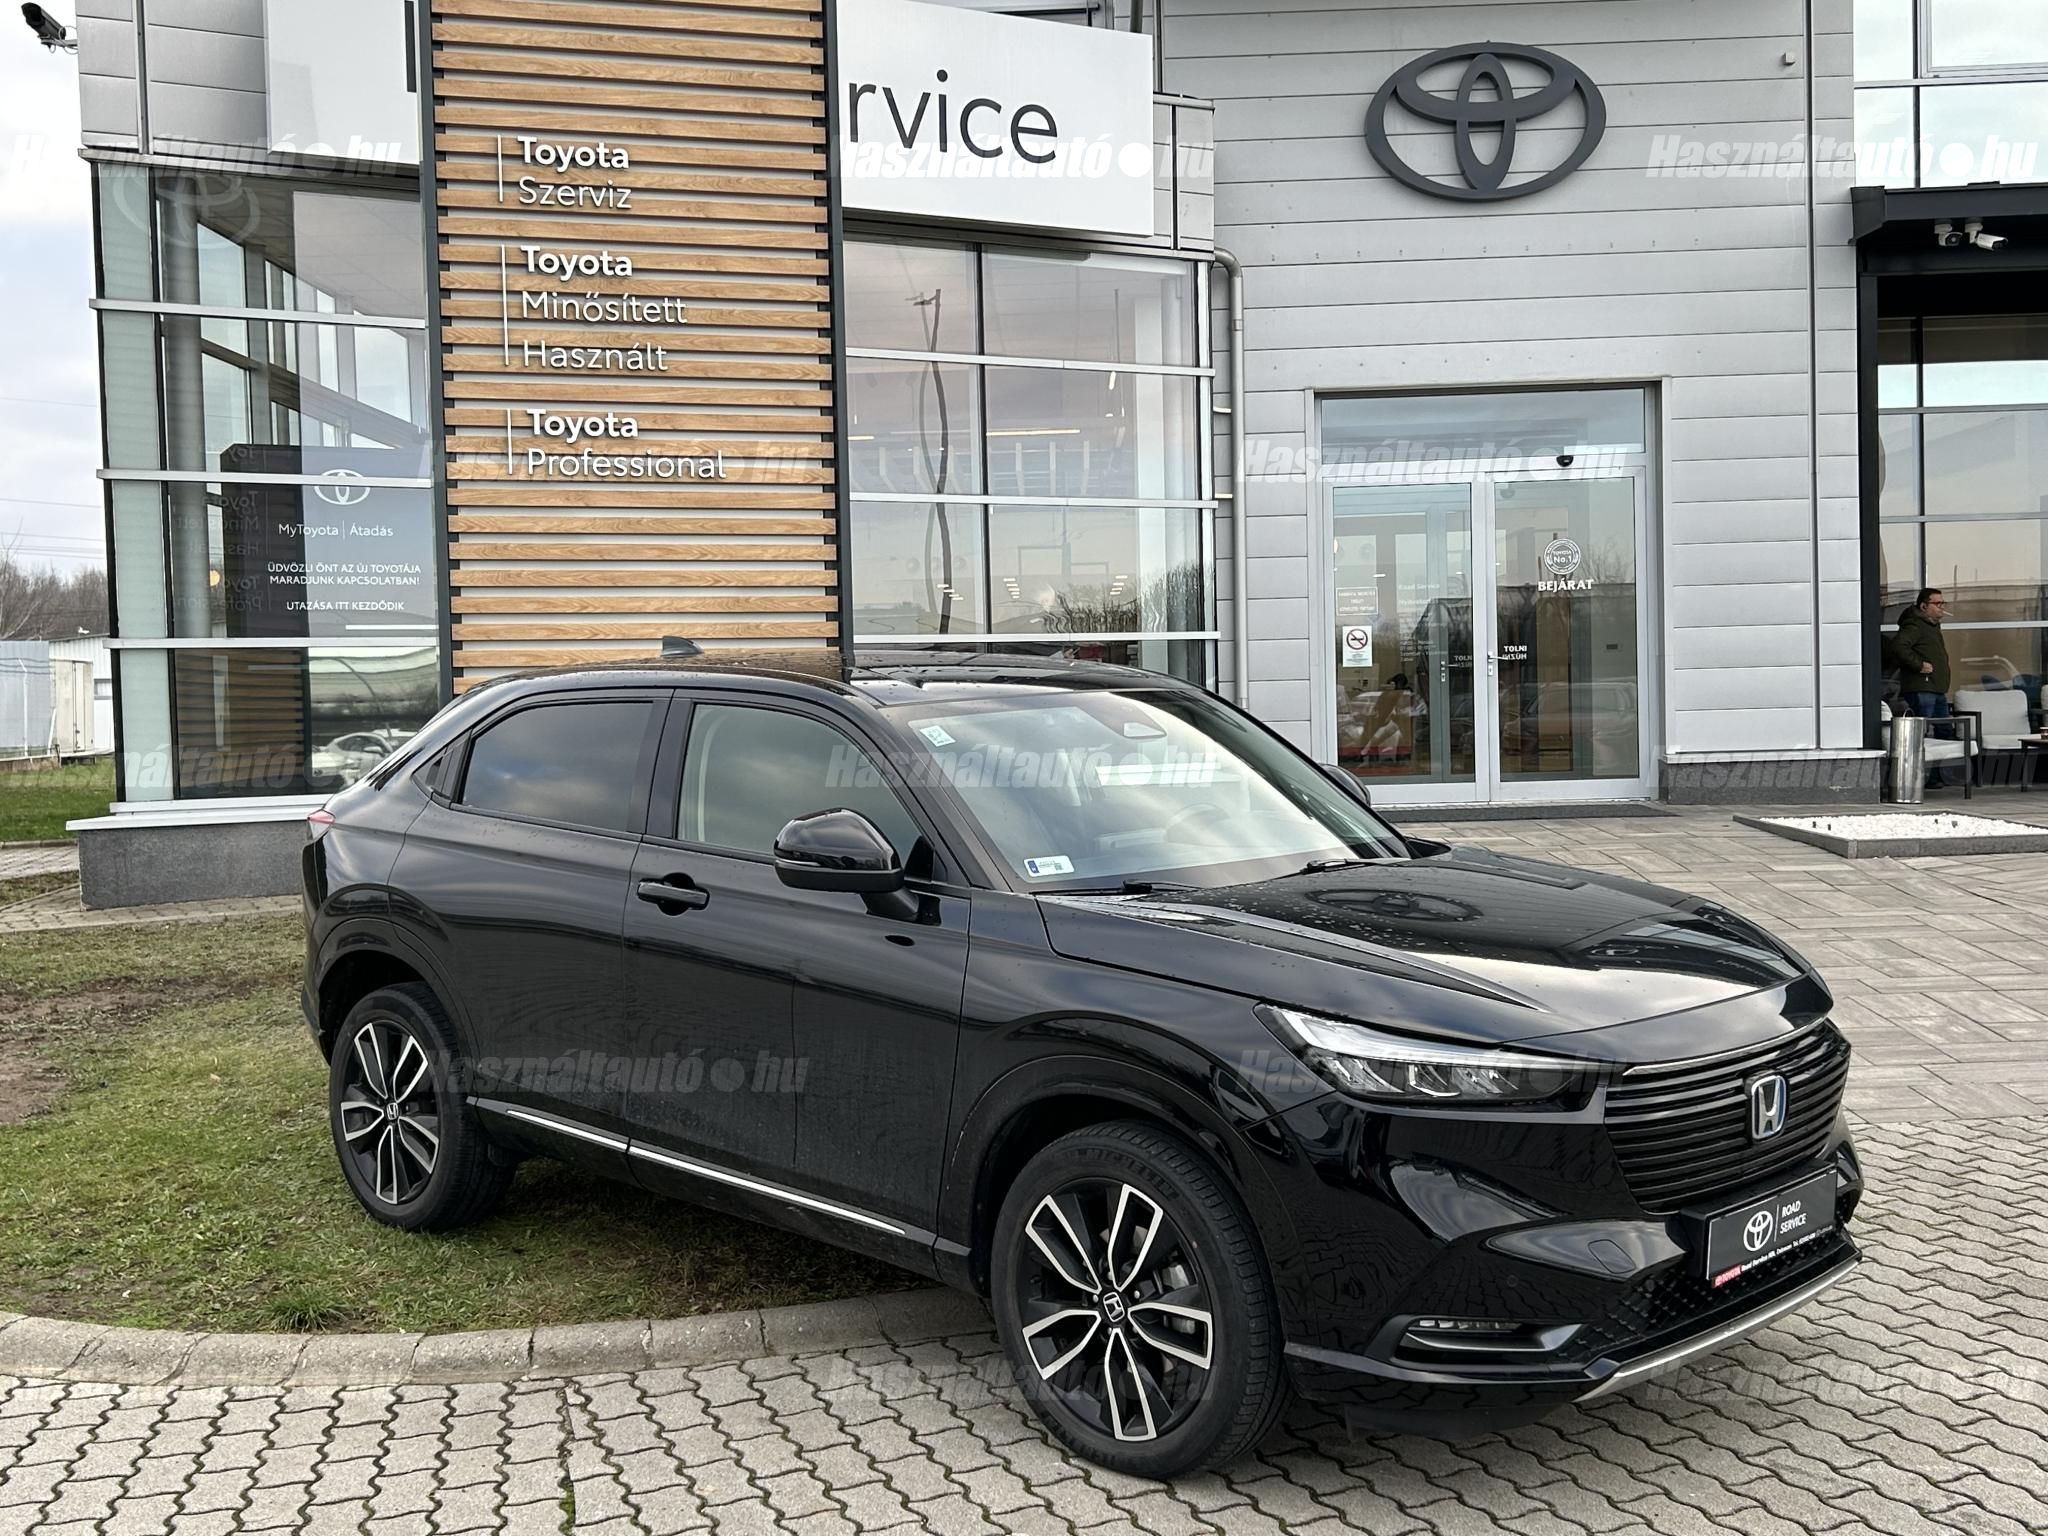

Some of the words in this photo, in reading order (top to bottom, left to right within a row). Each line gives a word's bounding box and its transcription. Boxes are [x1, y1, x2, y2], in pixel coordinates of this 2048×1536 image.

[517, 135, 629, 173] Toyota
[519, 176, 632, 209] Szerviz
[520, 245, 633, 281] Toyota
[522, 291, 687, 323] Minősített
[523, 340, 668, 371] Használt
[526, 408, 639, 444] Toyota
[528, 448, 726, 478] Professional
[278, 523, 339, 538] MyToyota
[350, 522, 394, 537] Átadás
[267, 562, 313, 573] ÜDVÖZLI
[341, 564, 354, 573] AZ
[371, 562, 421, 573] TOYOTÁJA
[269, 576, 334, 585] MARADJUNK
[337, 575, 420, 585] KAPCSOLATBAN!
[1537, 578, 1594, 592] BEJÁRAT
[286, 600, 333, 610] UTAZÁSA
[335, 601, 349, 610] ITT
[1781, 1200, 1801, 1218] ROAD
[1780, 1212, 1807, 1234] SERVICE
